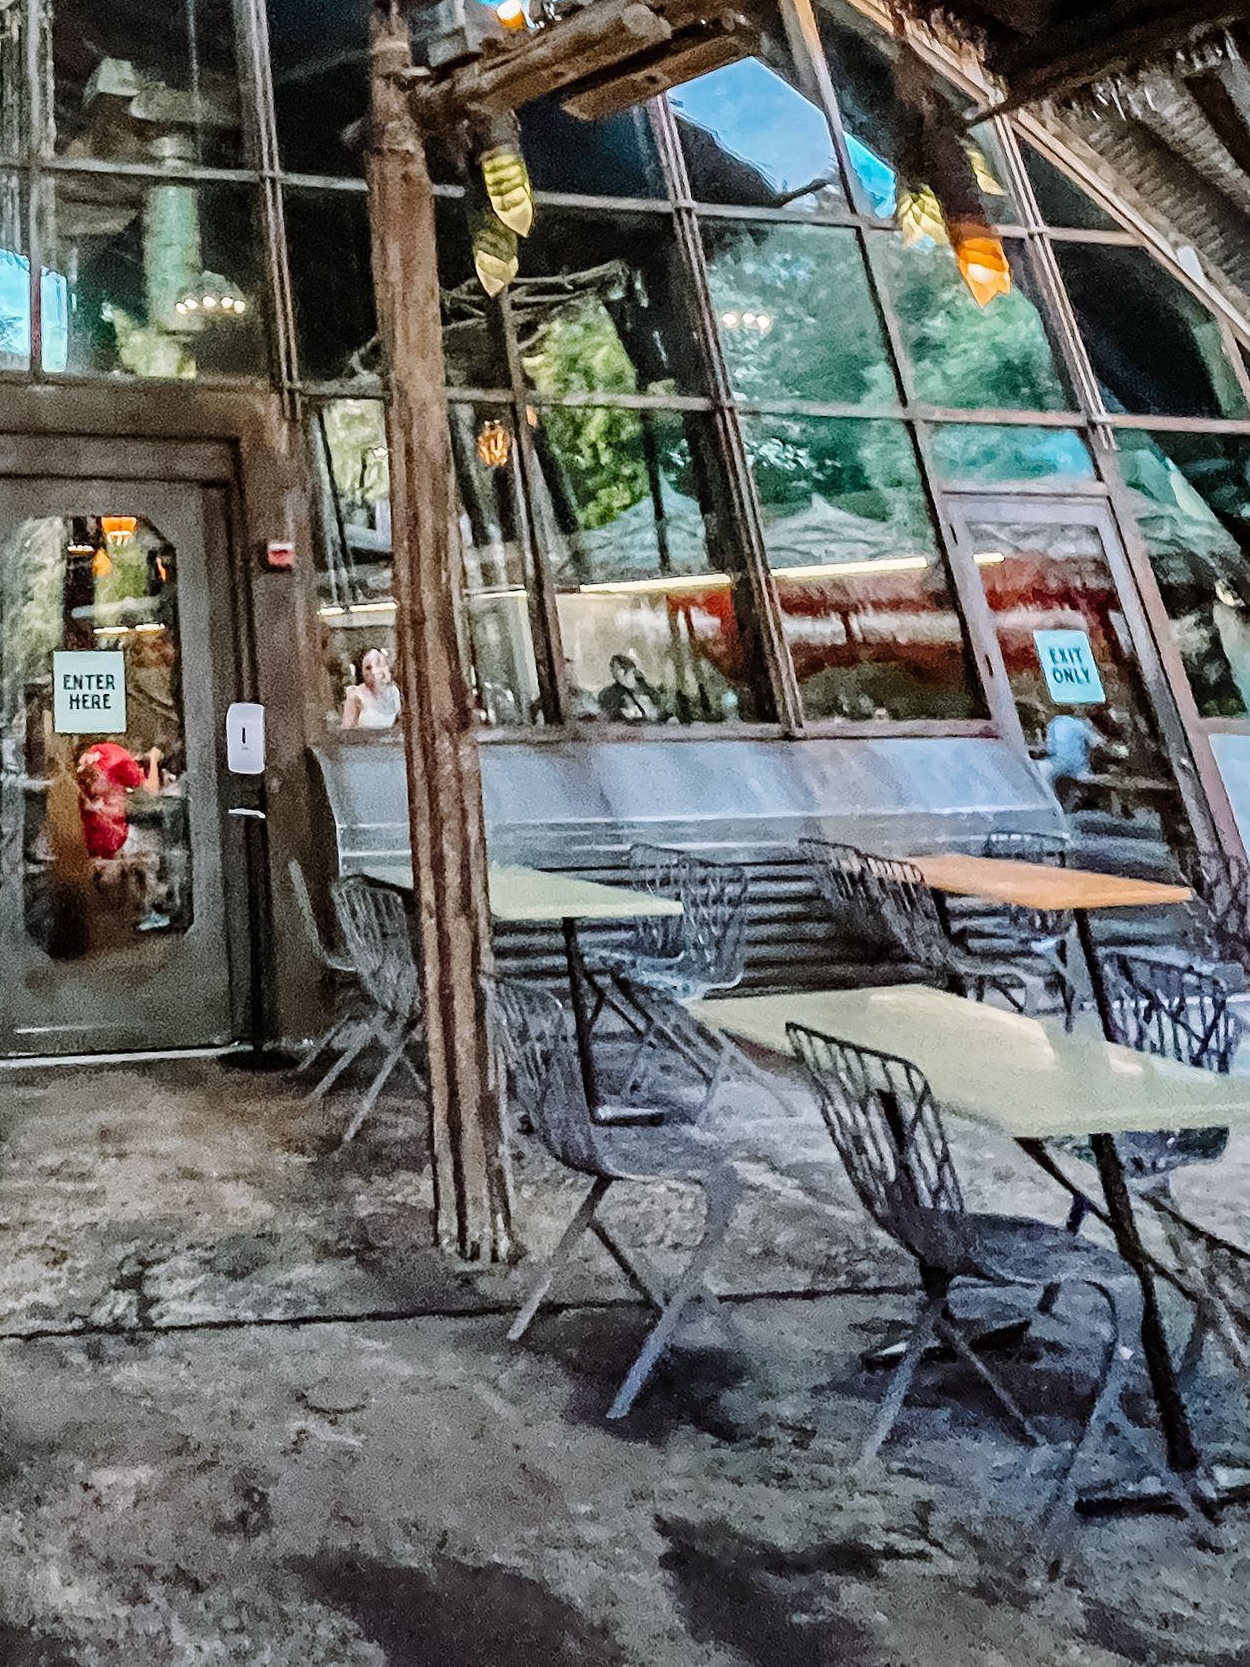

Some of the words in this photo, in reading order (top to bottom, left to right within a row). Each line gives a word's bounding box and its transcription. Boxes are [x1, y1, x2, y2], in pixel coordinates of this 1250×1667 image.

[1048, 646, 1084, 665] EXIT
[63, 674, 116, 690] ENTER
[1052, 667, 1091, 684] ONLY
[69, 693, 111, 710] HERE
